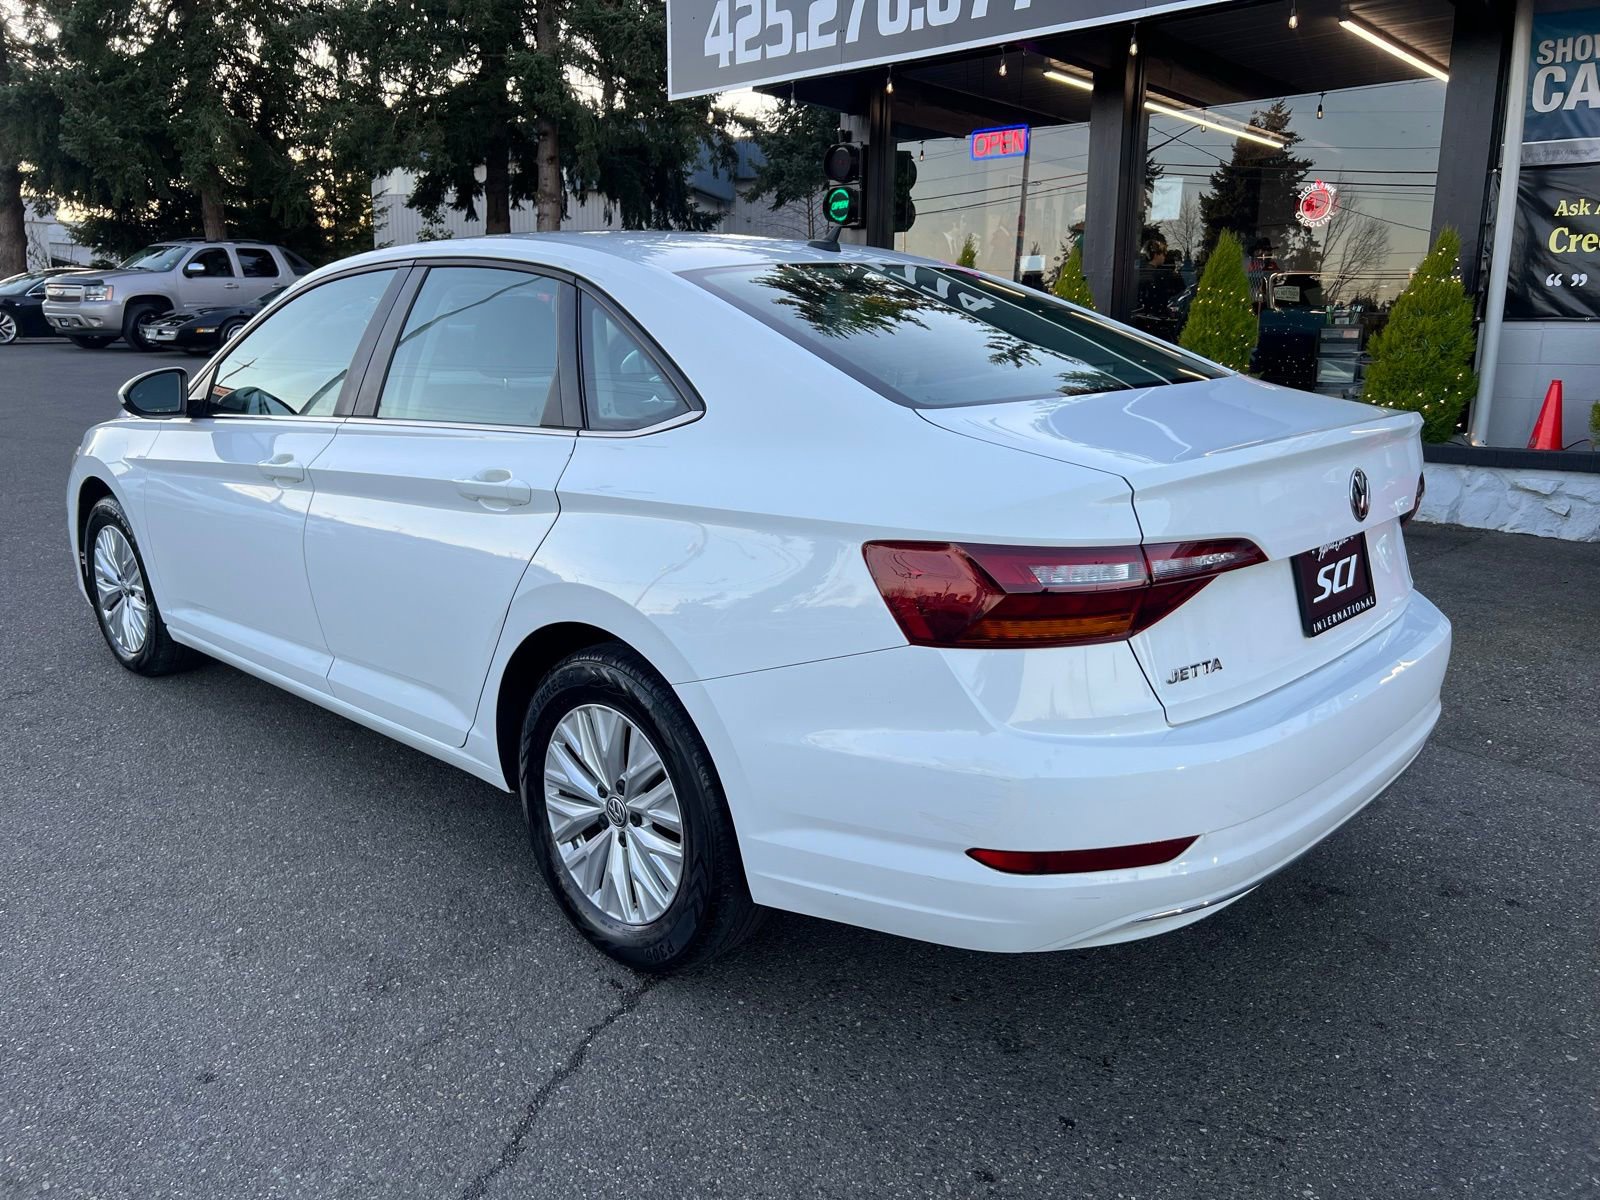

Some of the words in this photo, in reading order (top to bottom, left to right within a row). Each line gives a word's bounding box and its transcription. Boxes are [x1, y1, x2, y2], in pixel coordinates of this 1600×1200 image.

[1537, 33, 1600, 65] SHO
[974, 128, 1026, 158] OPEN
[831, 199, 850, 211] OPEN
[1295, 210, 1336, 228] GASOLINE
[1554, 199, 1591, 217] Ask
[1548, 226, 1600, 253] Cre
[1313, 554, 1358, 604] SCI
[1313, 596, 1375, 633] INTERNATIONAL
[1166, 657, 1223, 685] JETTA
